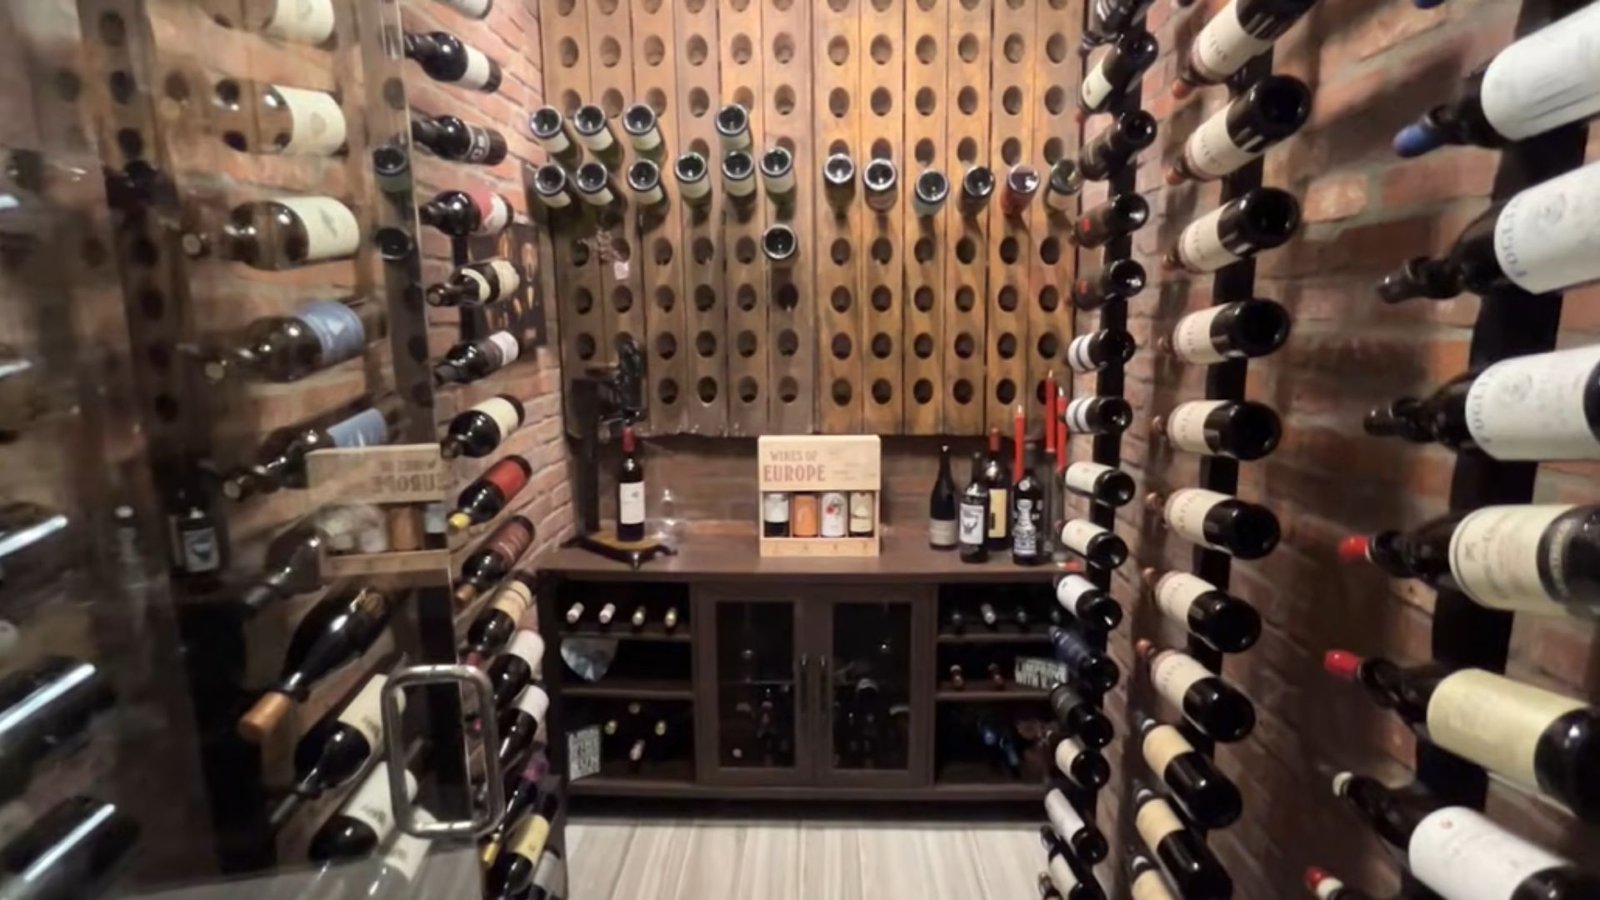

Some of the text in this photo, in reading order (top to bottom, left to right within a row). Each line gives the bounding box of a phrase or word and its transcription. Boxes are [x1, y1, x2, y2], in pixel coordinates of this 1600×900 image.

[770, 450, 818, 462] WINES OF
[763, 465, 826, 482] EUROPE
